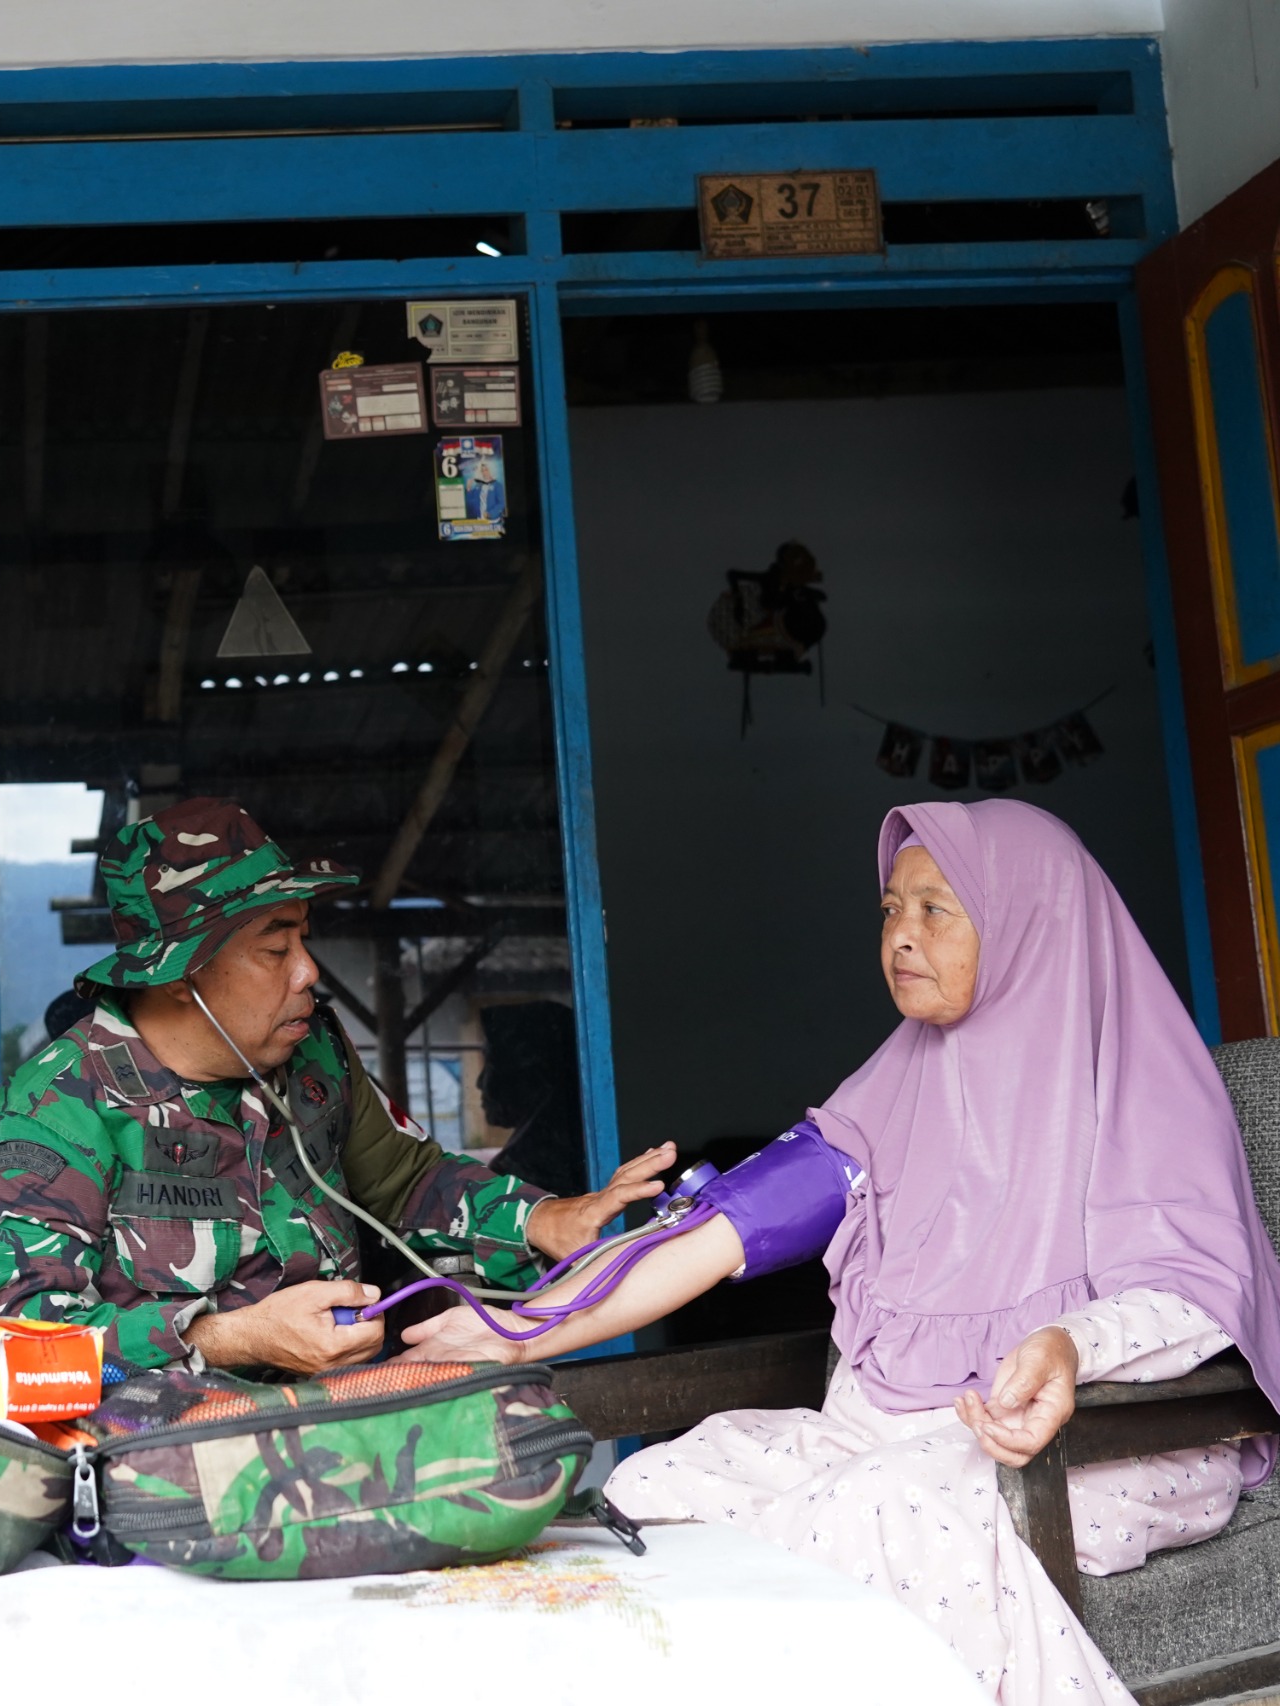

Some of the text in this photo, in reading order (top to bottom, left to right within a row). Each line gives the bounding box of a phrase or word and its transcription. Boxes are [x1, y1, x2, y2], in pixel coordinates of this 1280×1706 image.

[777, 182, 821, 219] 37
[837, 184, 853, 196] 02
[442, 456, 458, 478] 6
[285, 1143, 321, 1180] TNI
[137, 1183, 224, 1207] HANDRI
[14, 1370, 92, 1386] Yekamulvita
